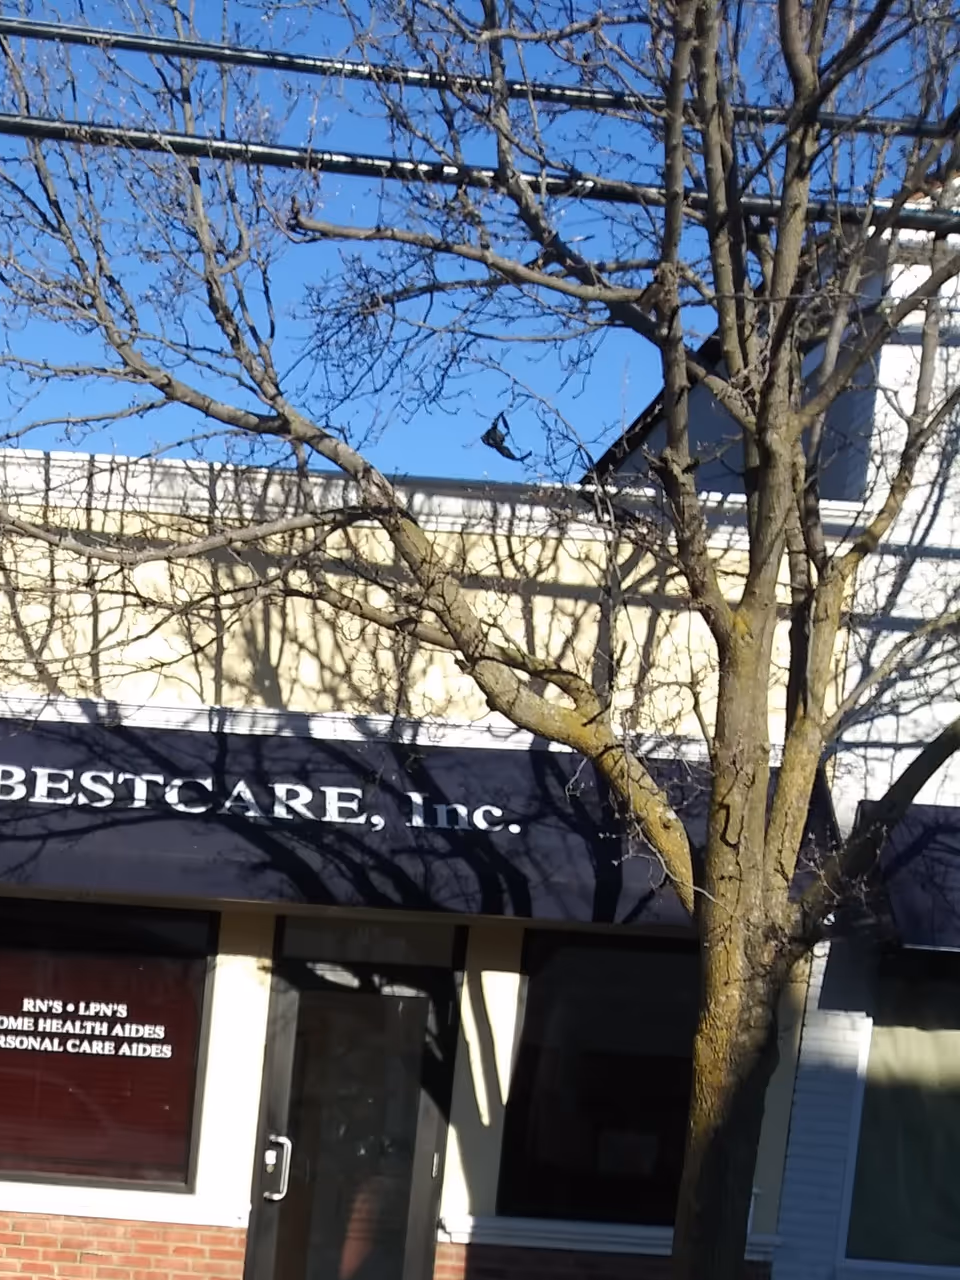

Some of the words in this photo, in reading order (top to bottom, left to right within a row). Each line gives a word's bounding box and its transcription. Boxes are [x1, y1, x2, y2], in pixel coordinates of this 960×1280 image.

[405, 791, 523, 835] Inc.
[22, 997, 63, 1014] RN'S
[78, 1001, 128, 1018] LPN'S
[37, 1017, 108, 1036] HEALTH
[111, 1022, 165, 1039] AIDES
[66, 1038, 115, 1055] CARE
[117, 1042, 172, 1059] AIDES
